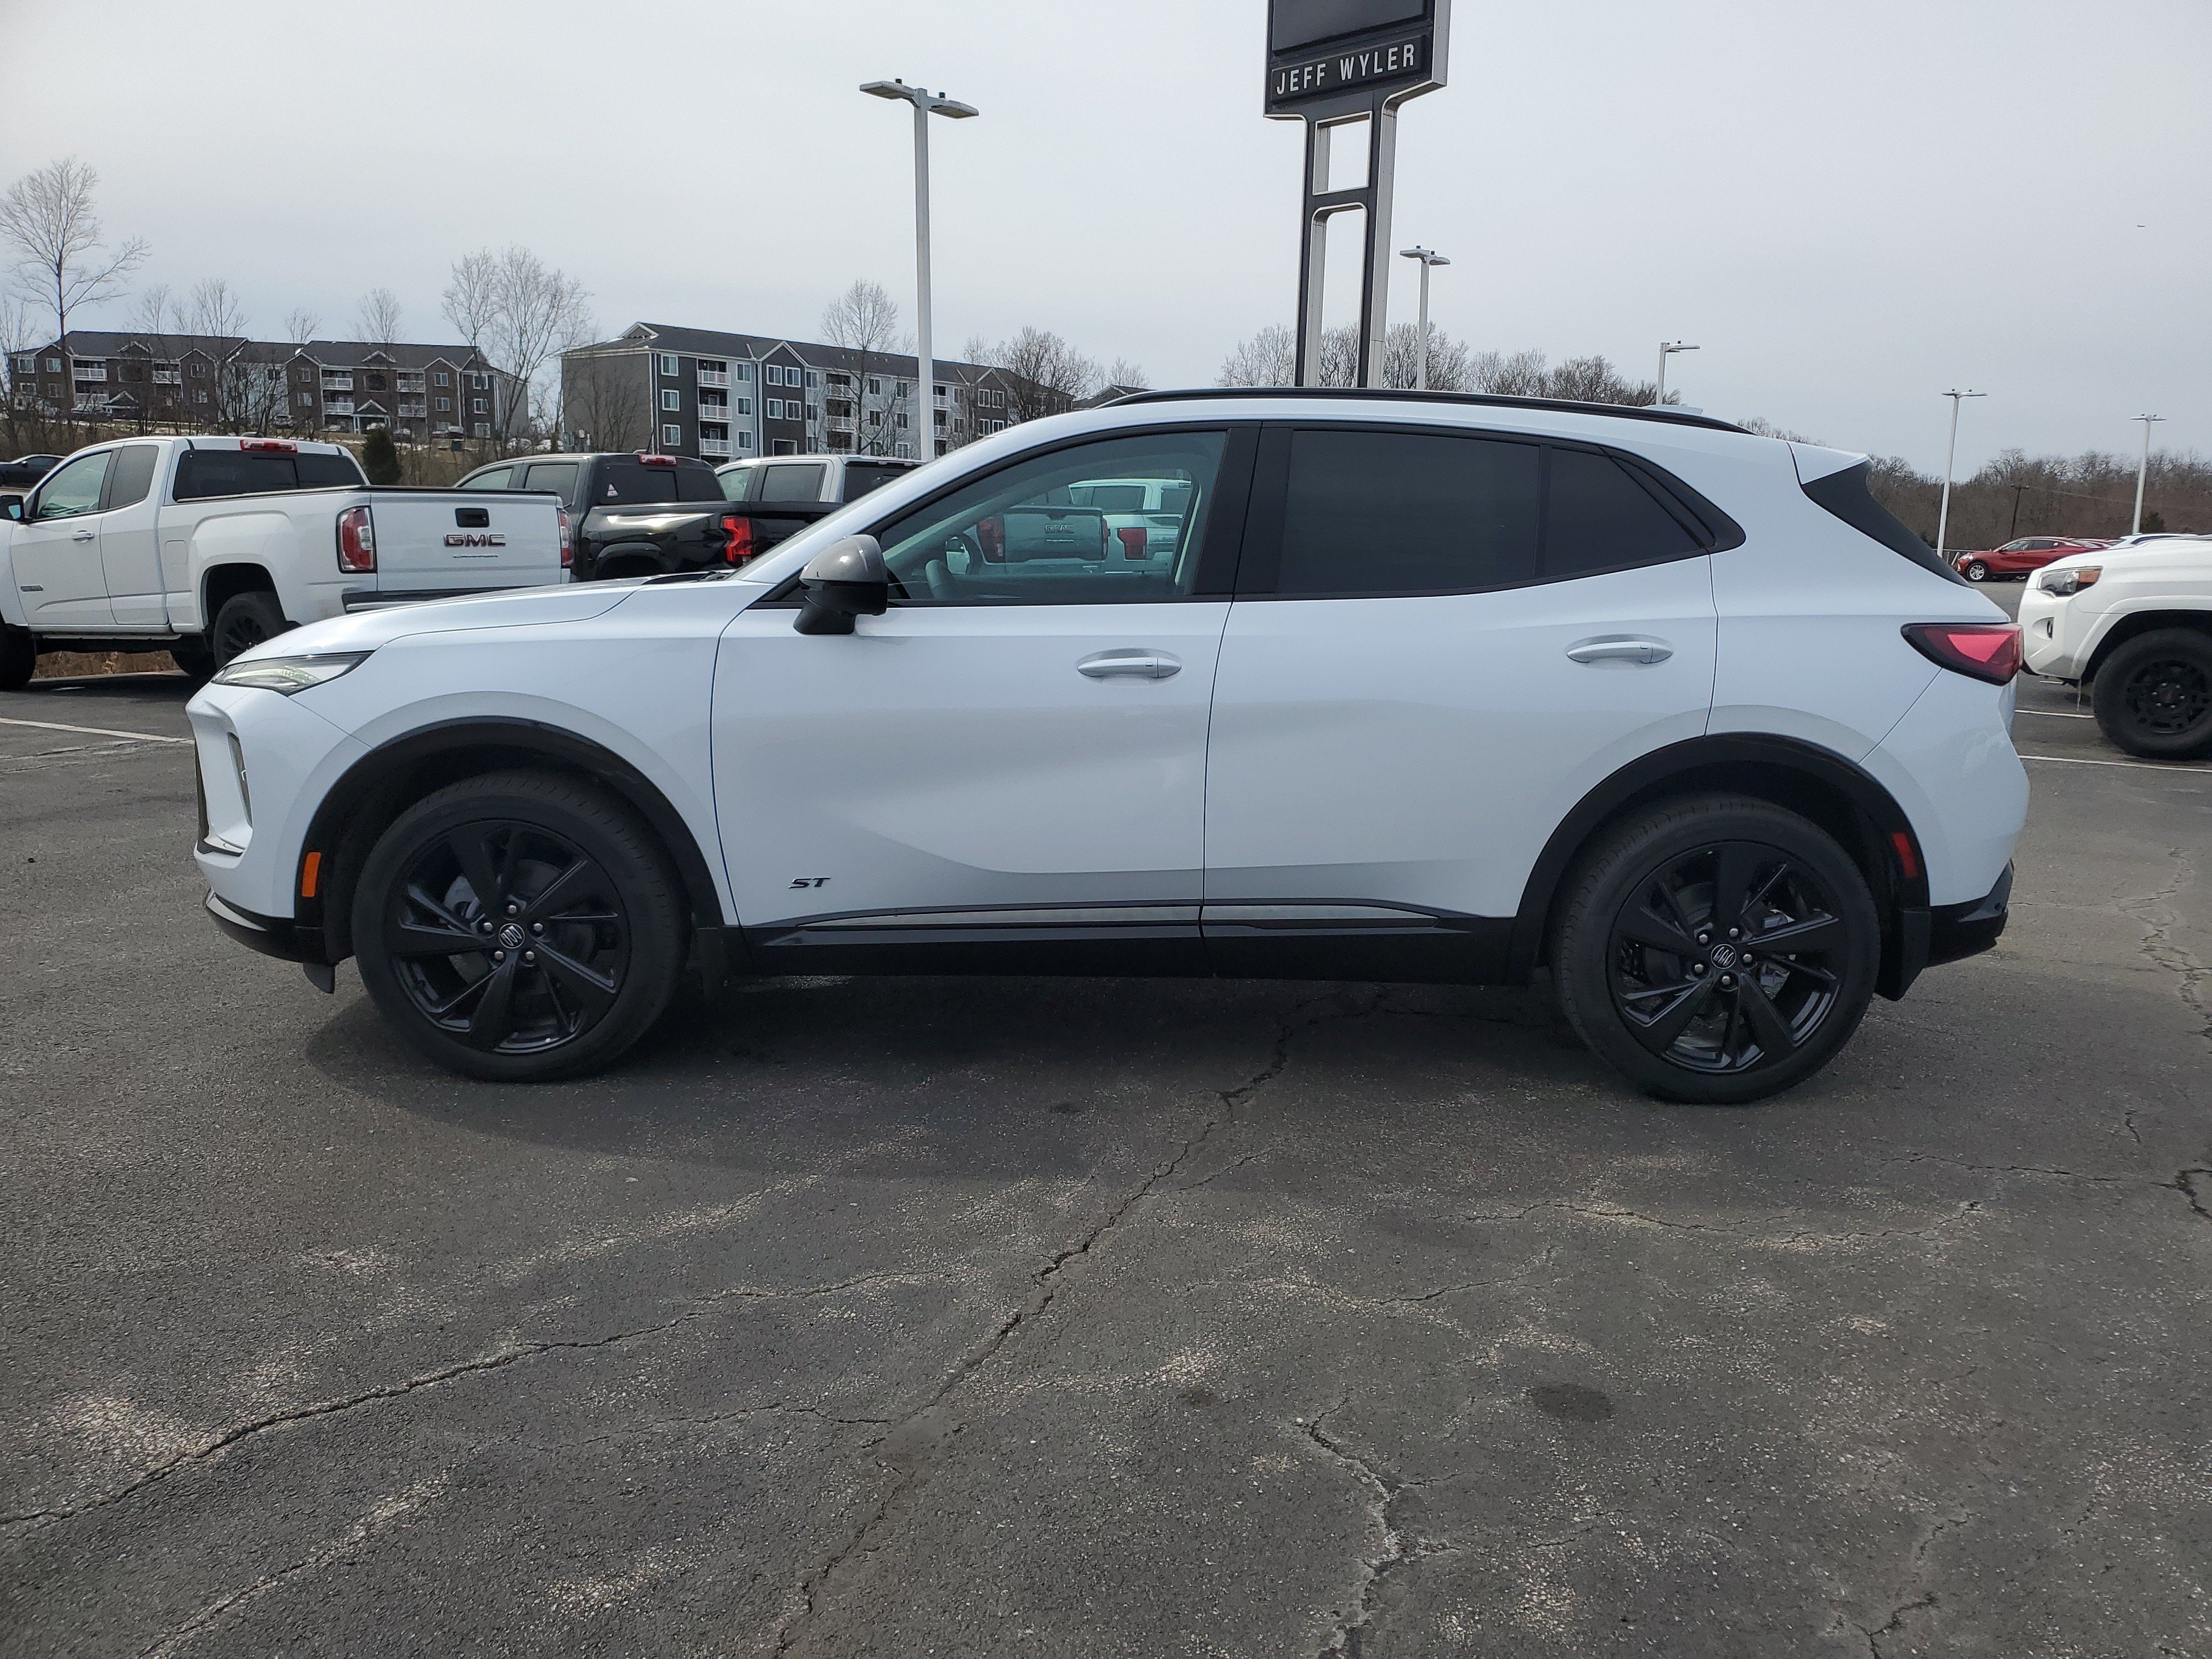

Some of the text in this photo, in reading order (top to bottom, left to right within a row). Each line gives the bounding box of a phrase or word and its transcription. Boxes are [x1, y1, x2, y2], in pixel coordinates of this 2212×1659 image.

[1276, 43, 1414, 95] JEFF WYLER
[1045, 524, 1075, 534] GMC
[444, 533, 506, 547] GMC
[788, 877, 831, 889] ST
